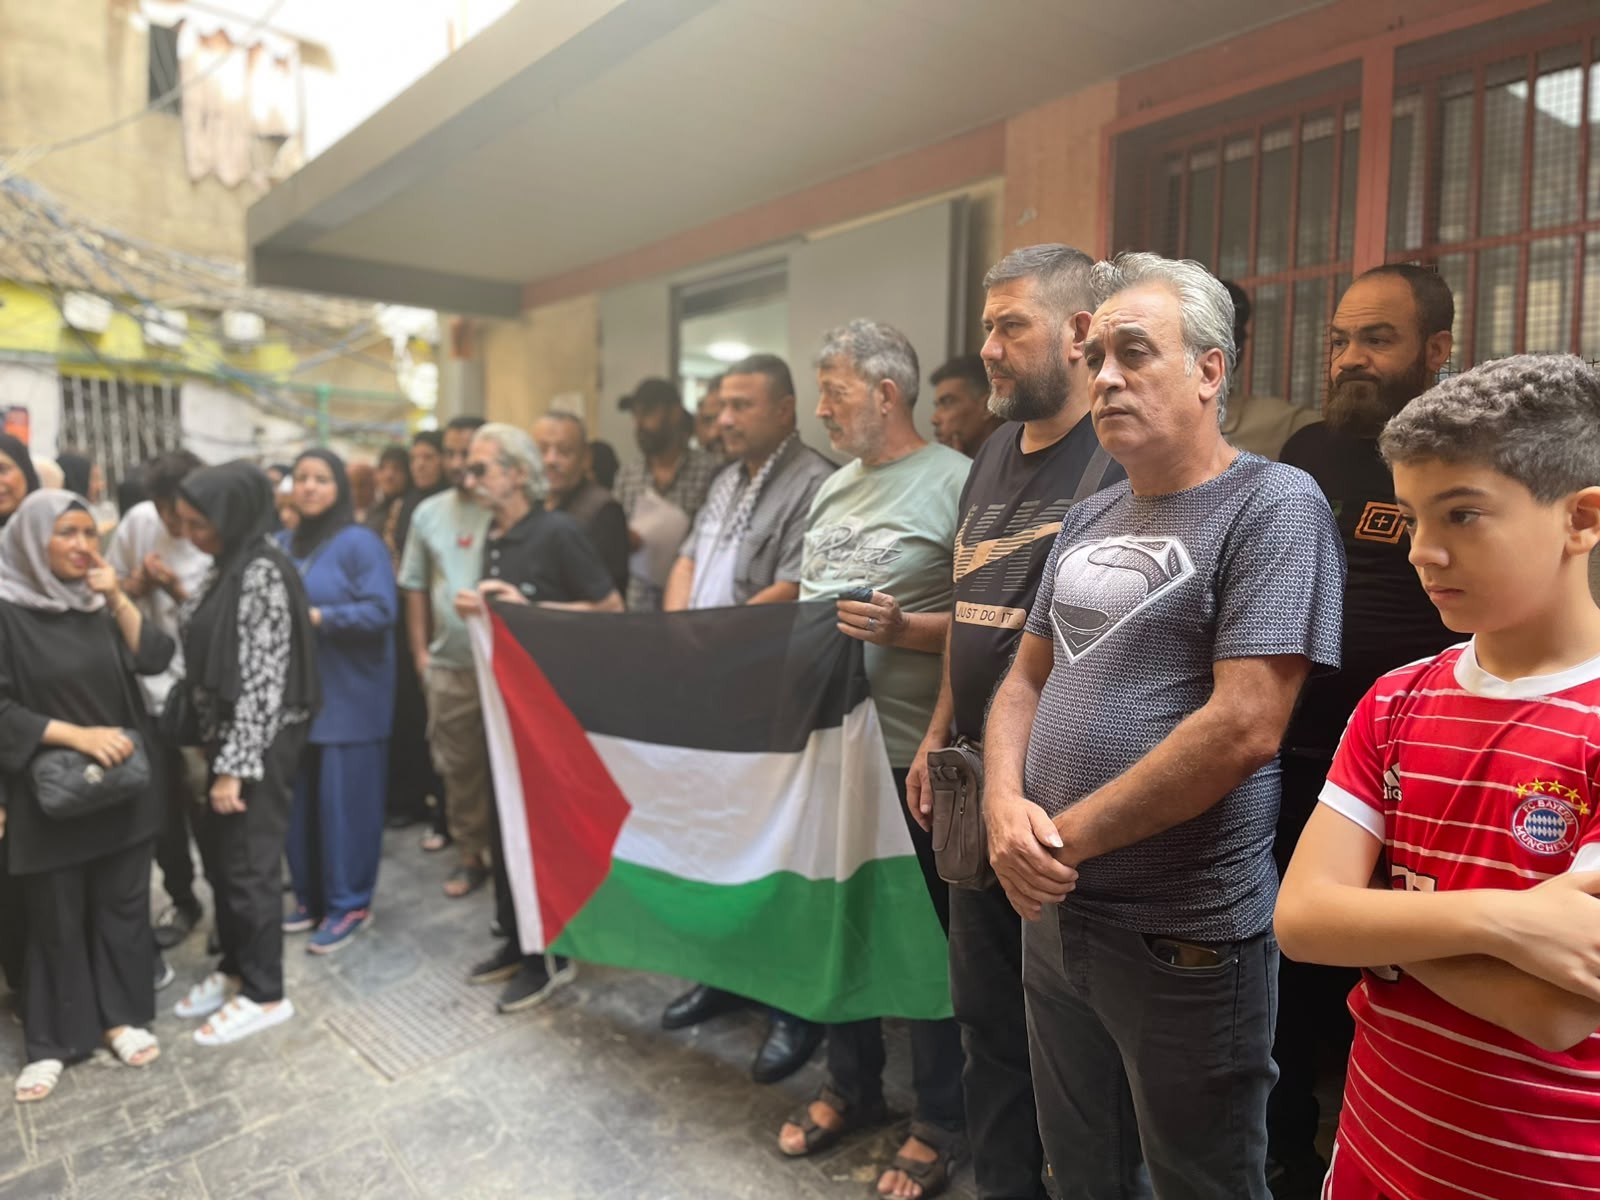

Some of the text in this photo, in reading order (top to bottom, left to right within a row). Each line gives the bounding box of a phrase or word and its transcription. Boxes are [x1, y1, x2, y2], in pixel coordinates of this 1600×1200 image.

[956, 606, 978, 619] JUST
[980, 609, 996, 621] DO
[1522, 799, 1575, 825] FC BAYERN
